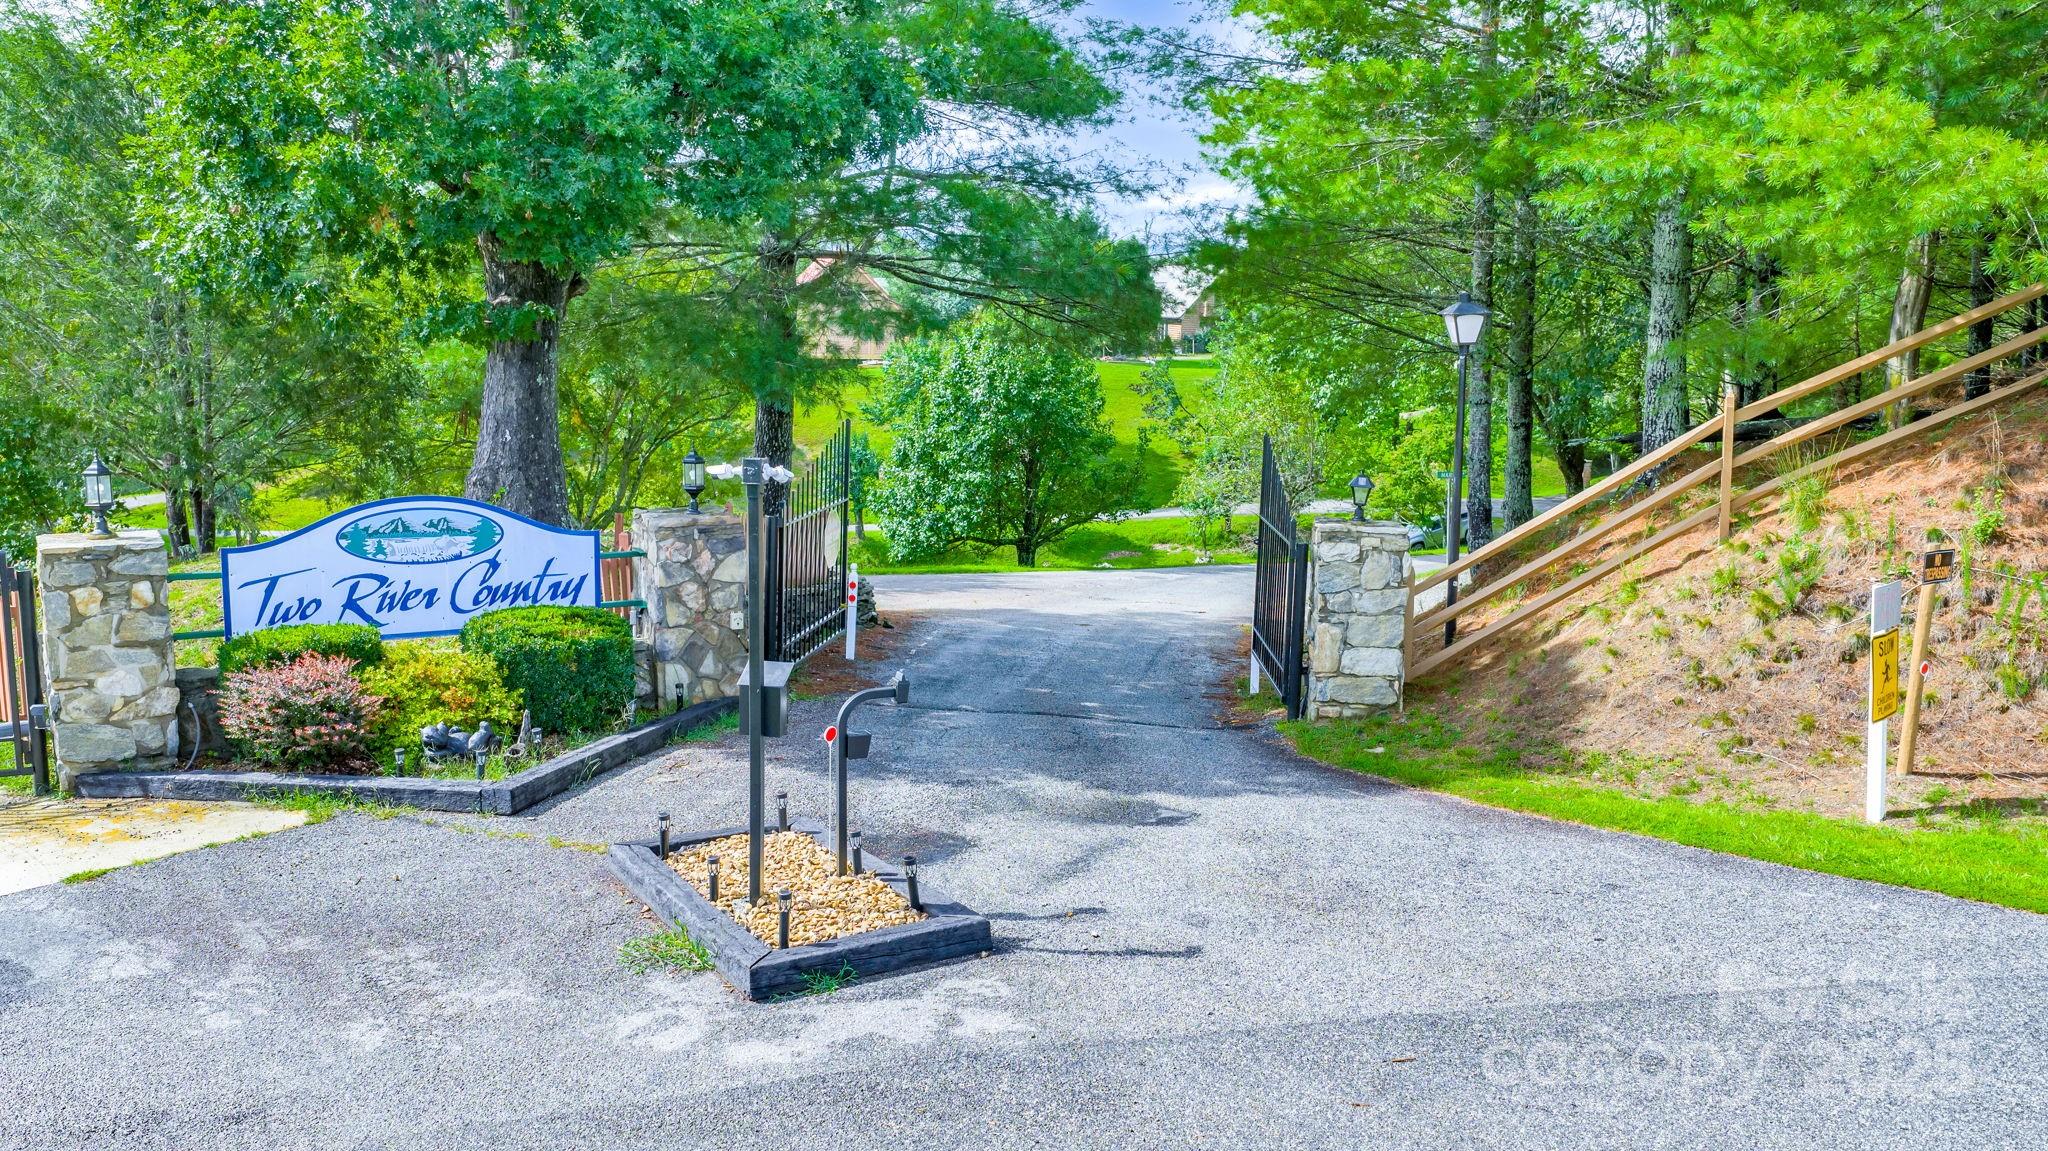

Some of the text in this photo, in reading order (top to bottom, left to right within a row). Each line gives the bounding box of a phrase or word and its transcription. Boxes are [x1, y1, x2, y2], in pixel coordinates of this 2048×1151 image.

[238, 549, 589, 628] Two River Country
[1878, 637, 1895, 657] SLOW
